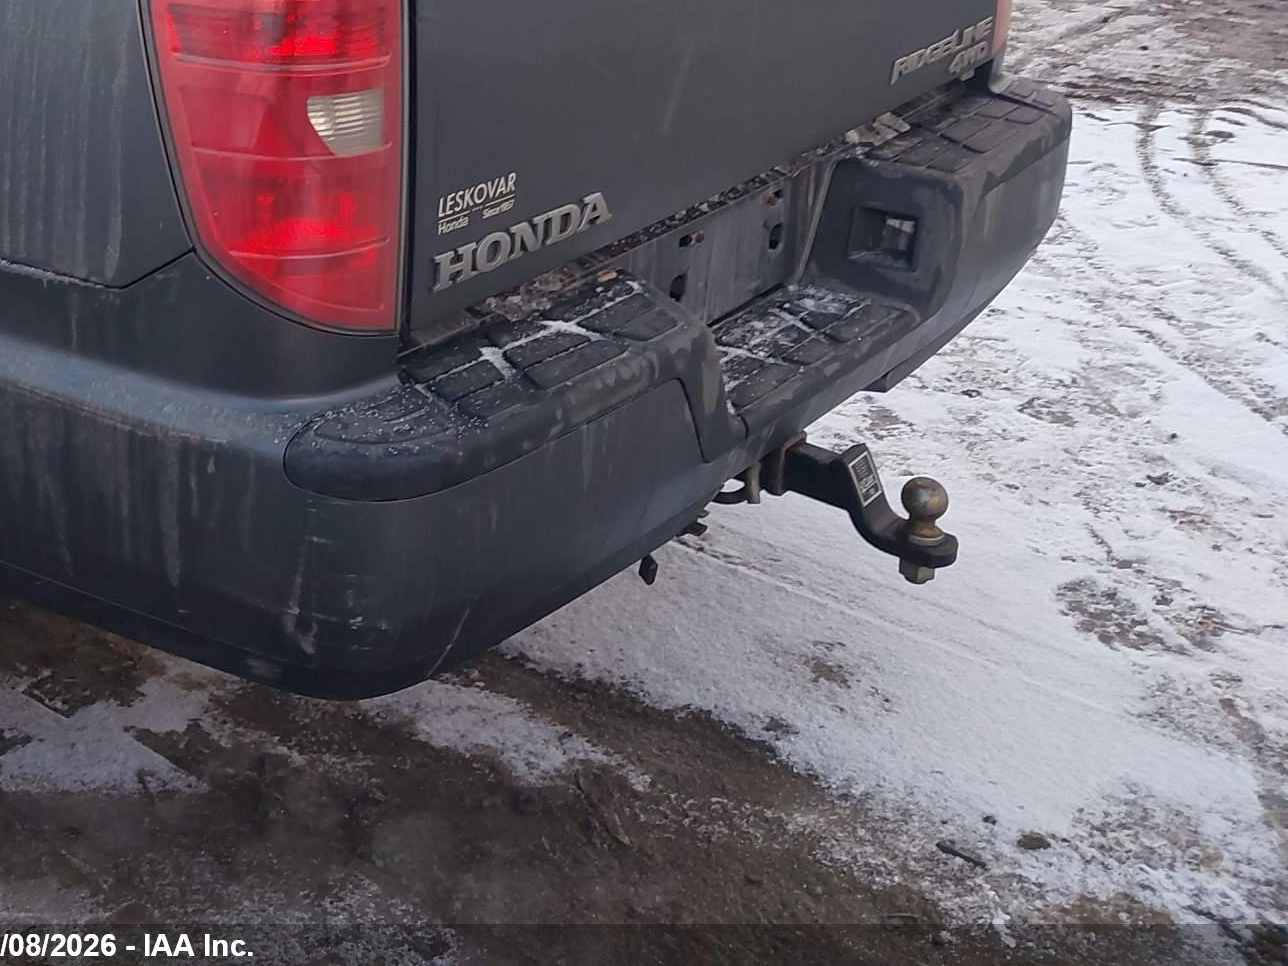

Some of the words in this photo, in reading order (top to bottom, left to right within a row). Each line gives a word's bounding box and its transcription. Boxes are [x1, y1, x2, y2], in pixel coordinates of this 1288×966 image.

[438, 171, 517, 218] LESKOVAR
[432, 191, 612, 292] HONDA
[438, 215, 470, 234] Honda
